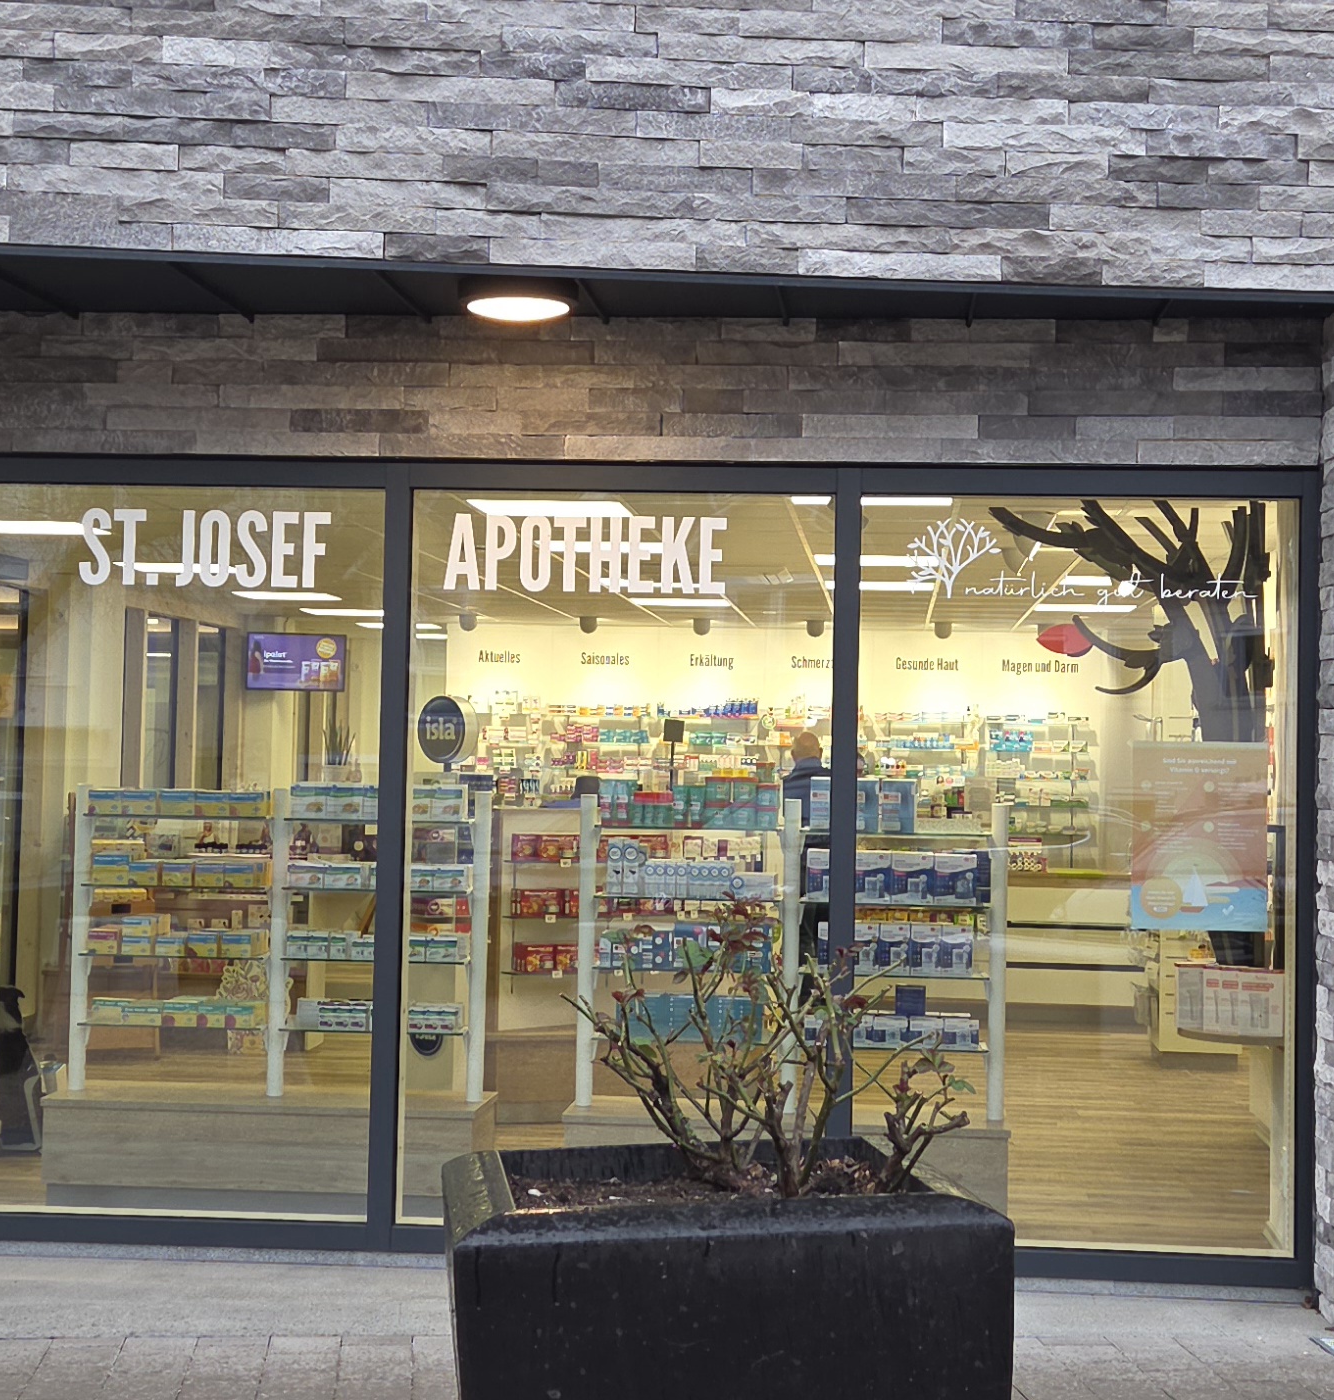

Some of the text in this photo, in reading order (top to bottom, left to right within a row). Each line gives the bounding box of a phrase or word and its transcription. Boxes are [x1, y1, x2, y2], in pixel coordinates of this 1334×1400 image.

[78, 508, 728, 594] ST. JOSEF APOTHEKE
[965, 567, 1259, 606] natürlich gut beraten
[478, 650, 521, 664] Aktuelles
[580, 652, 630, 666] Saisonales
[689, 654, 735, 671] Erkältung
[895, 657, 959, 671] Gesunde Haut
[1001, 659, 1079, 675] Magen und Darm
[425, 716, 456, 740] isla
